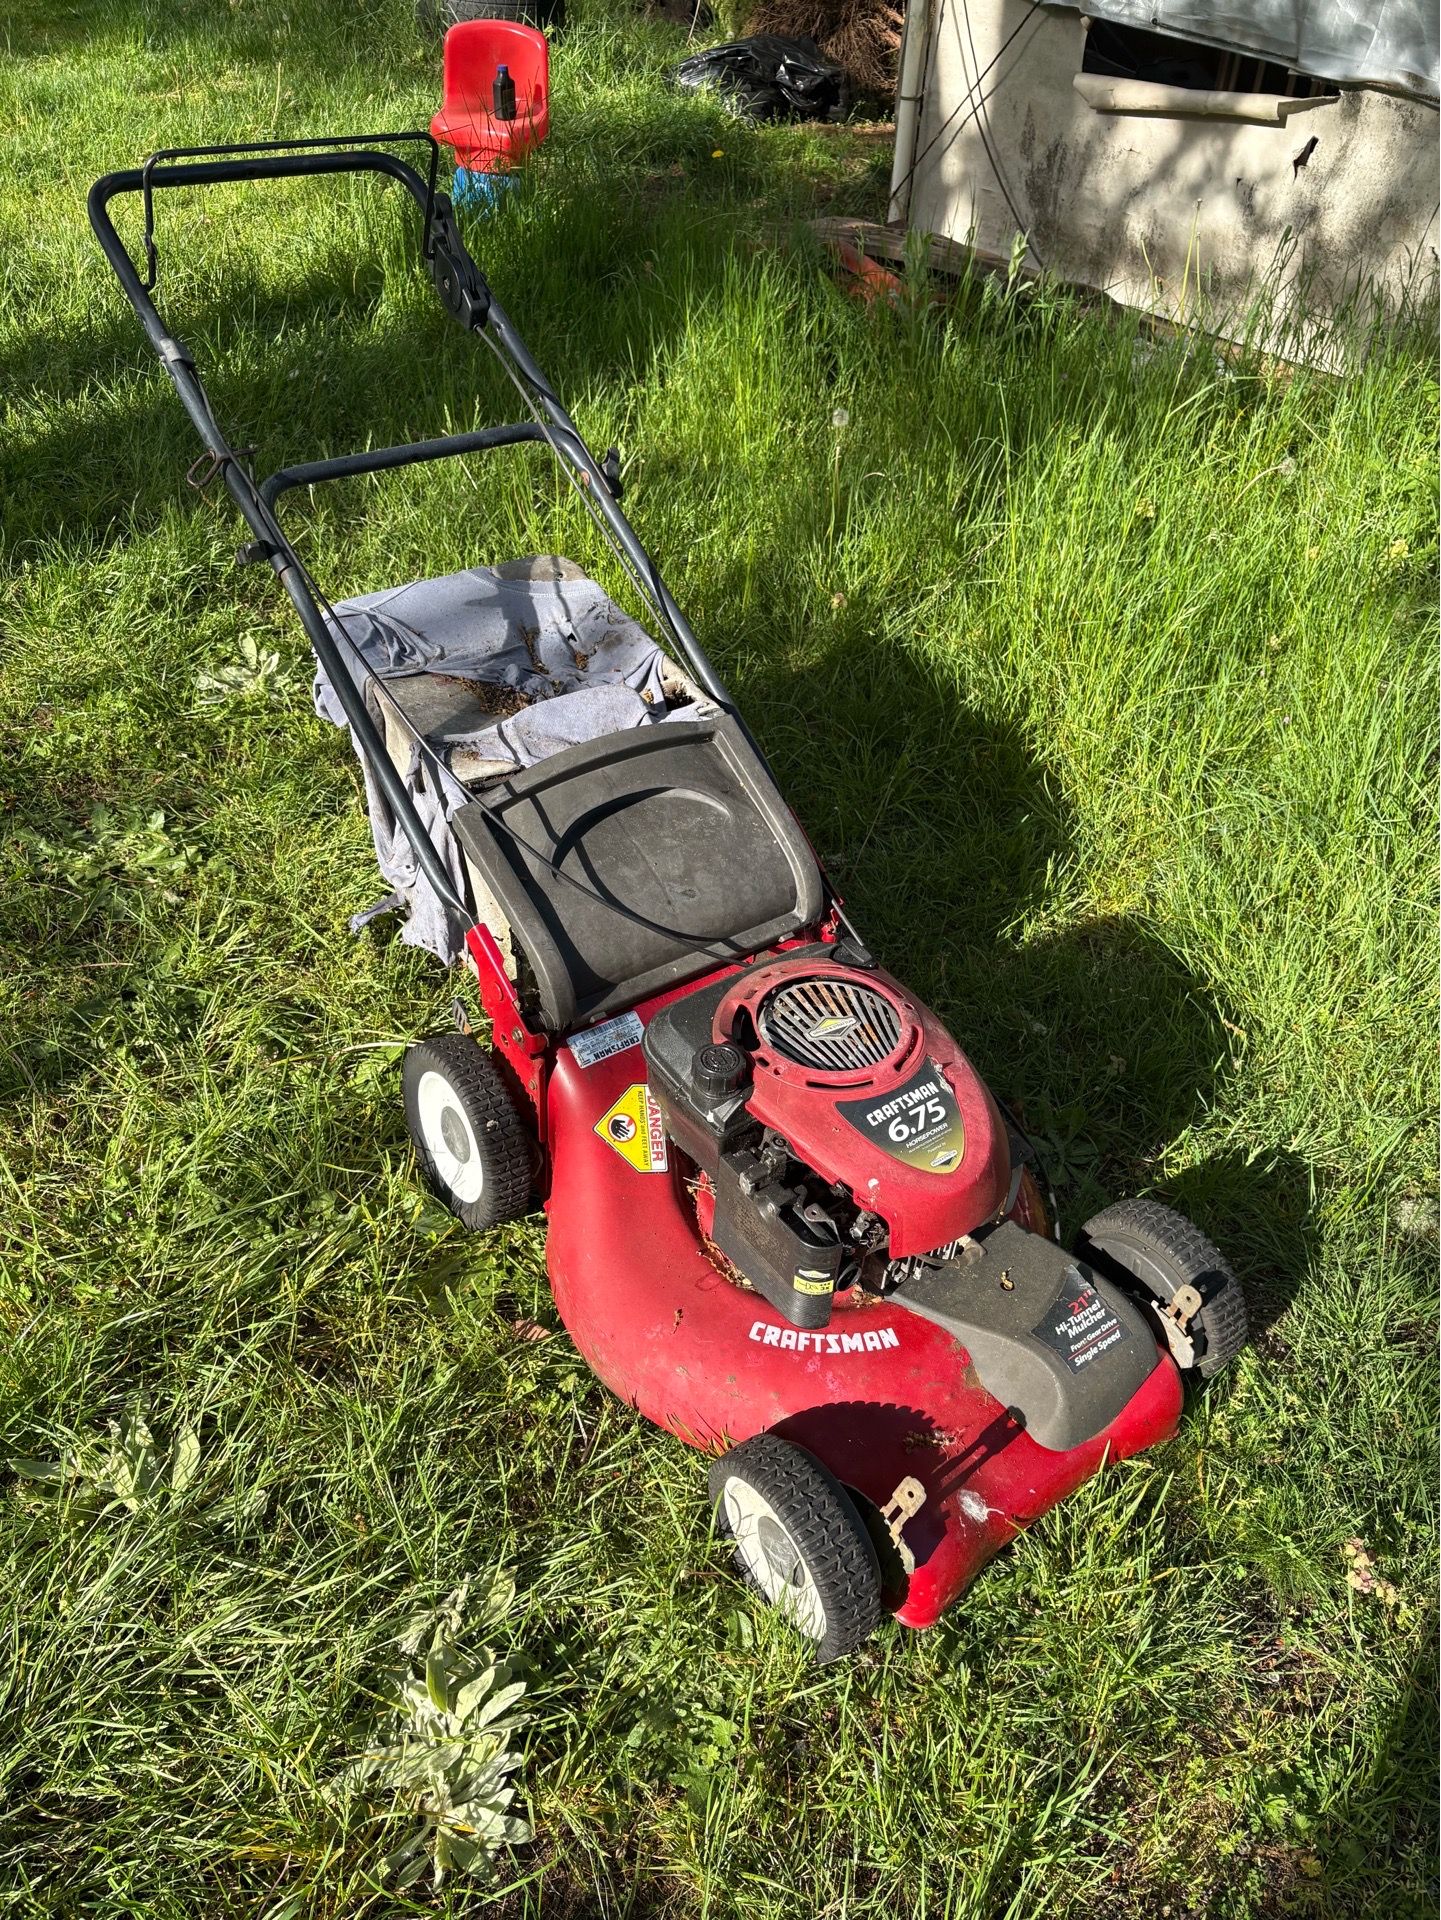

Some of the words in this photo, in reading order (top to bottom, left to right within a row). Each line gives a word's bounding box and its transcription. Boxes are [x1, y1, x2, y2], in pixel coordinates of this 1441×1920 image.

[593, 1036, 640, 1060] CRAFTSMAN
[866, 1081, 939, 1126] CRAFTSMAN
[888, 1097, 946, 1142] 6.75
[647, 1096, 664, 1162] DANGER
[906, 1122, 948, 1148] HORSEPOWER
[1054, 1299, 1102, 1335] Hi-Tunnel
[1067, 1289, 1093, 1315] 21"
[748, 1321, 900, 1354] CRAFTSMAN
[1067, 1308, 1106, 1338] Mulcher
[1087, 1329, 1102, 1341] Gear
[1100, 1318, 1117, 1331] Drive
[1074, 1345, 1099, 1367] Single
[1097, 1329, 1121, 1350] Speed
